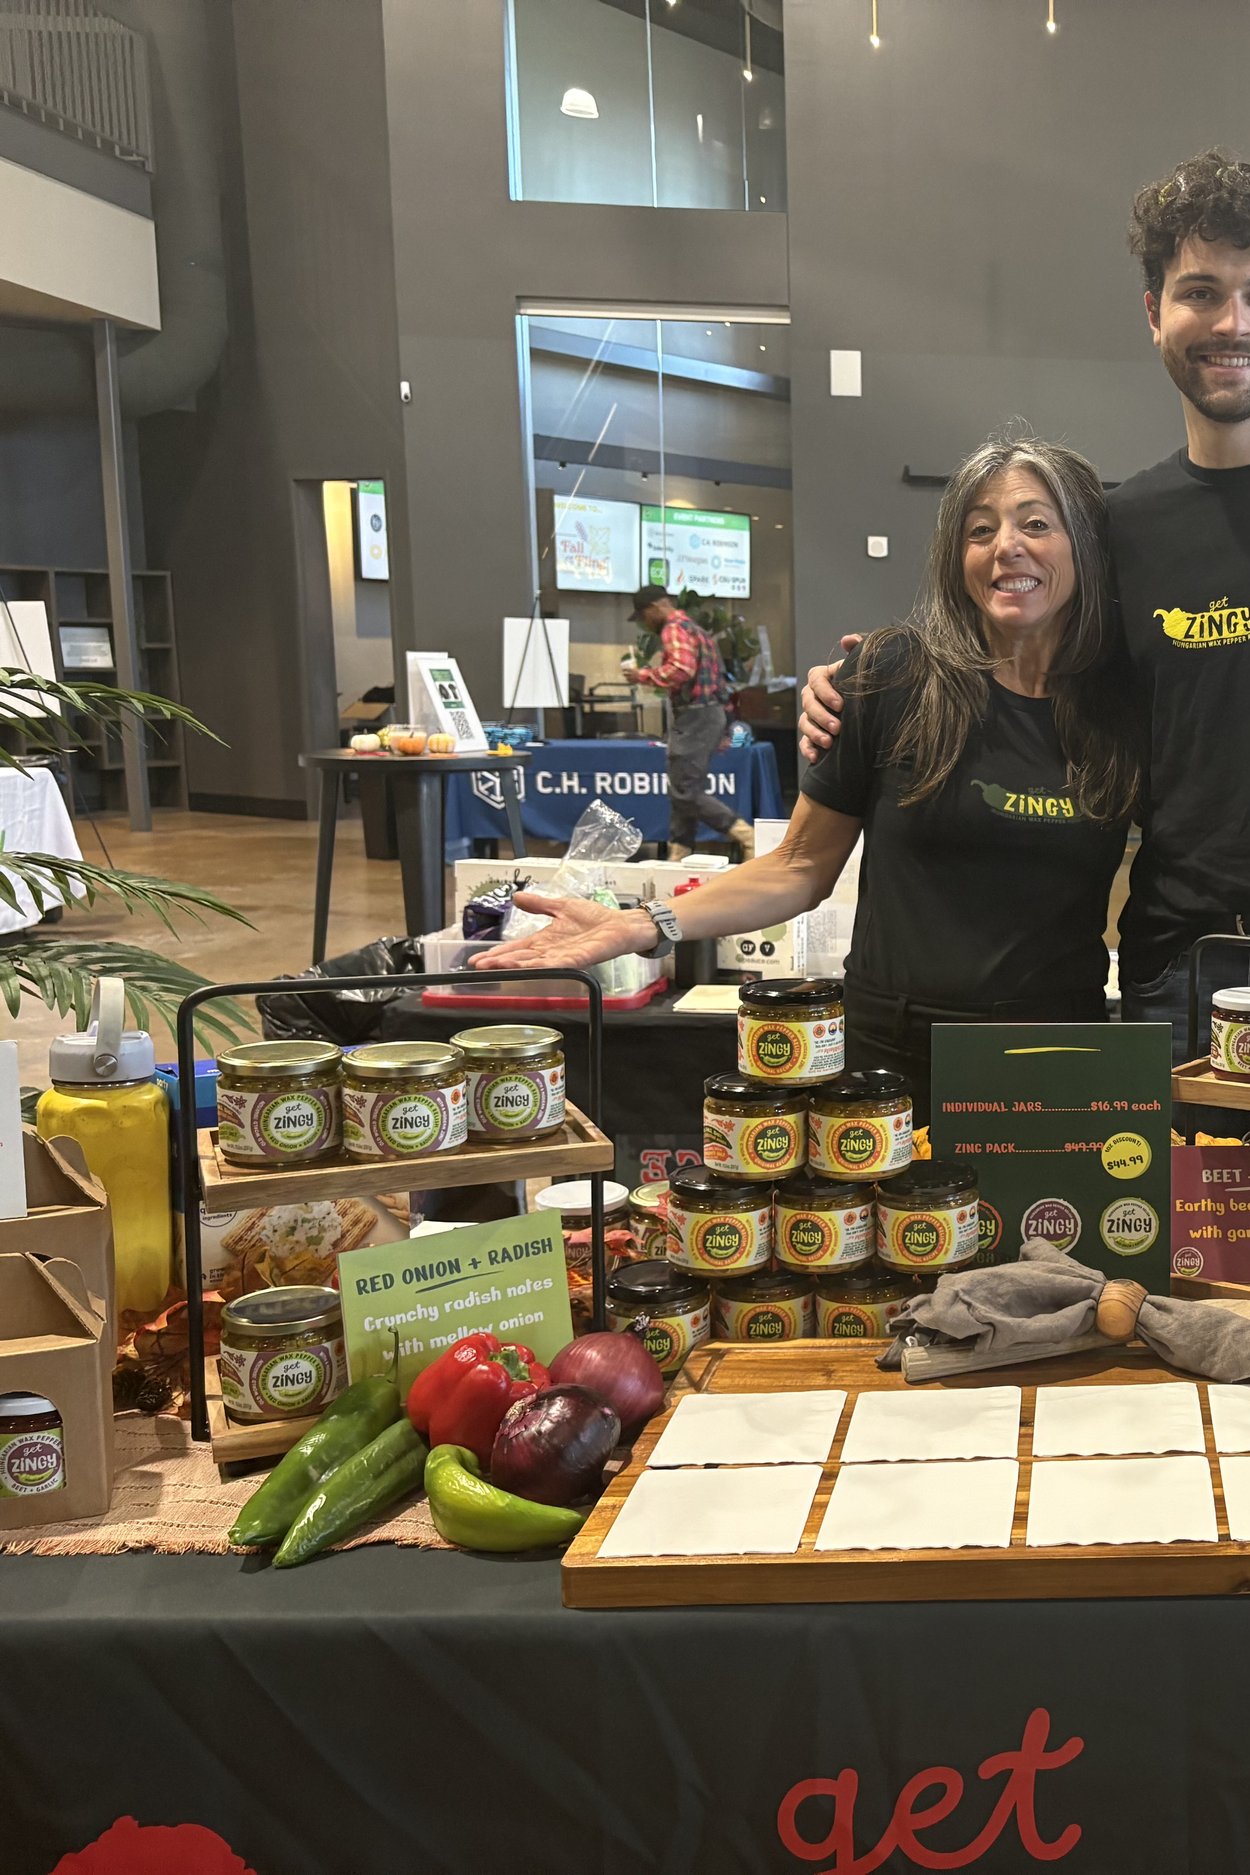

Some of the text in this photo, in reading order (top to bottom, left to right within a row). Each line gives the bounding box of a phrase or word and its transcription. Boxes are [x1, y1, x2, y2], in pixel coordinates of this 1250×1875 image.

[673, 512, 725, 525] EVENT PARTNERS
[1209, 596, 1229, 612] get
[1172, 640, 1207, 649] HUNGARIAN
[1223, 636, 1247, 646] PEPPER
[536, 771, 736, 795] C.H. ROBINON
[767, 1033, 780, 1042] get
[504, 1084, 519, 1094] get
[281, 1095, 295, 1103] WAX
[285, 1103, 301, 1114] get
[402, 1105, 418, 1115] get
[942, 1102, 1008, 1113] INDIVIDUAL
[1132, 1101, 1161, 1111] each
[766, 1127, 780, 1137] get
[849, 1129, 863, 1137] get
[1112, 1136, 1142, 1147] DISCOUNT!
[955, 1143, 976, 1153] ZING
[1106, 1155, 1144, 1170] $44.99
[1202, 1169, 1242, 1183] BEET
[1122, 1208, 1136, 1217] get
[1175, 1199, 1225, 1215] Earthy
[1044, 1209, 1059, 1219] get
[715, 1224, 730, 1234] get
[800, 1222, 812, 1230] get
[913, 1222, 926, 1230] get
[1189, 1225, 1222, 1239] with
[355, 1237, 554, 1296] RED ONION + RADISH
[364, 1277, 554, 1333] Crunchy radish notes
[759, 1313, 773, 1323] get
[841, 1313, 855, 1323] get
[383, 1337, 424, 1361] with
[499, 1310, 544, 1330] onion
[280, 1353, 294, 1361] WAX
[283, 1361, 300, 1373] get
[19, 1436, 34, 1444] WAX
[23, 1444, 42, 1456] get
[11, 1477, 59, 1493] BEET GARLIC
[777, 1707, 1085, 1875] get
